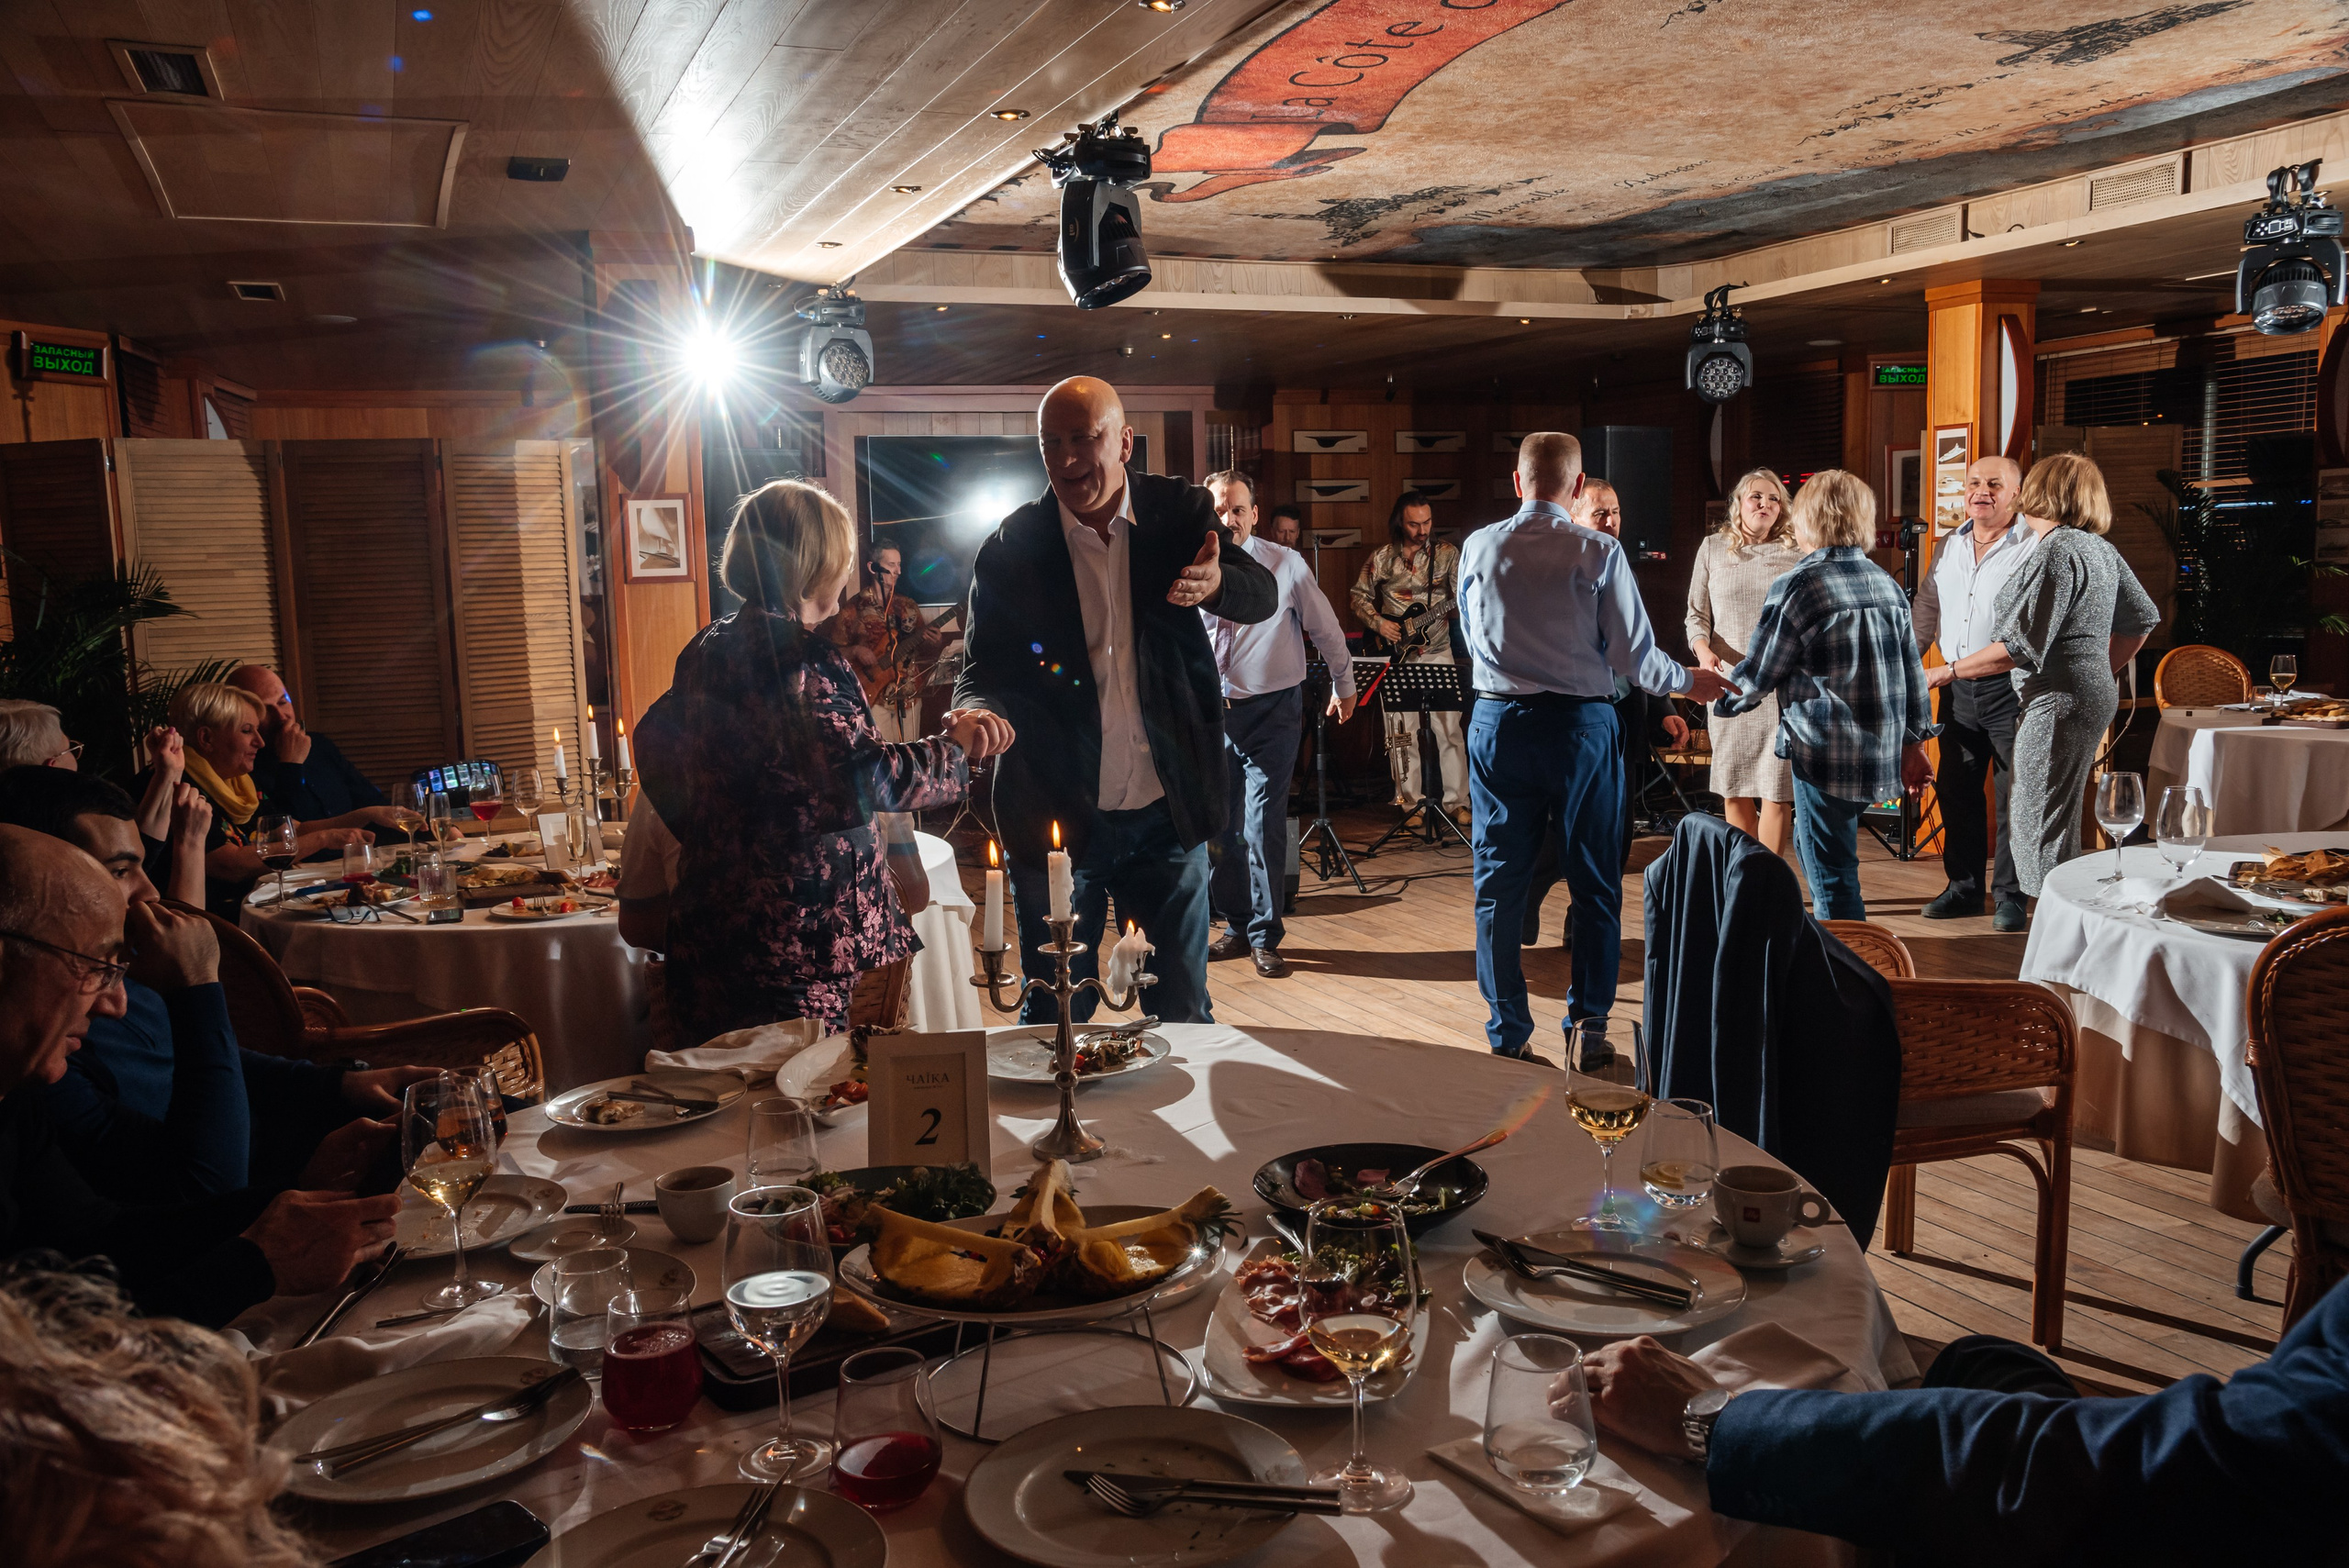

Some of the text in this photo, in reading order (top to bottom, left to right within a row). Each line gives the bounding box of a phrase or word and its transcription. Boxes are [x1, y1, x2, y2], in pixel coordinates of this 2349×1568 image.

[1288, 21, 1445, 88] Côte
[34, 345, 95, 360] ЗАПАСНЫЙ
[33, 356, 94, 375] ВЫХОД
[1879, 373, 1926, 384] ВЫХОД
[914, 1107, 942, 1146] 2
